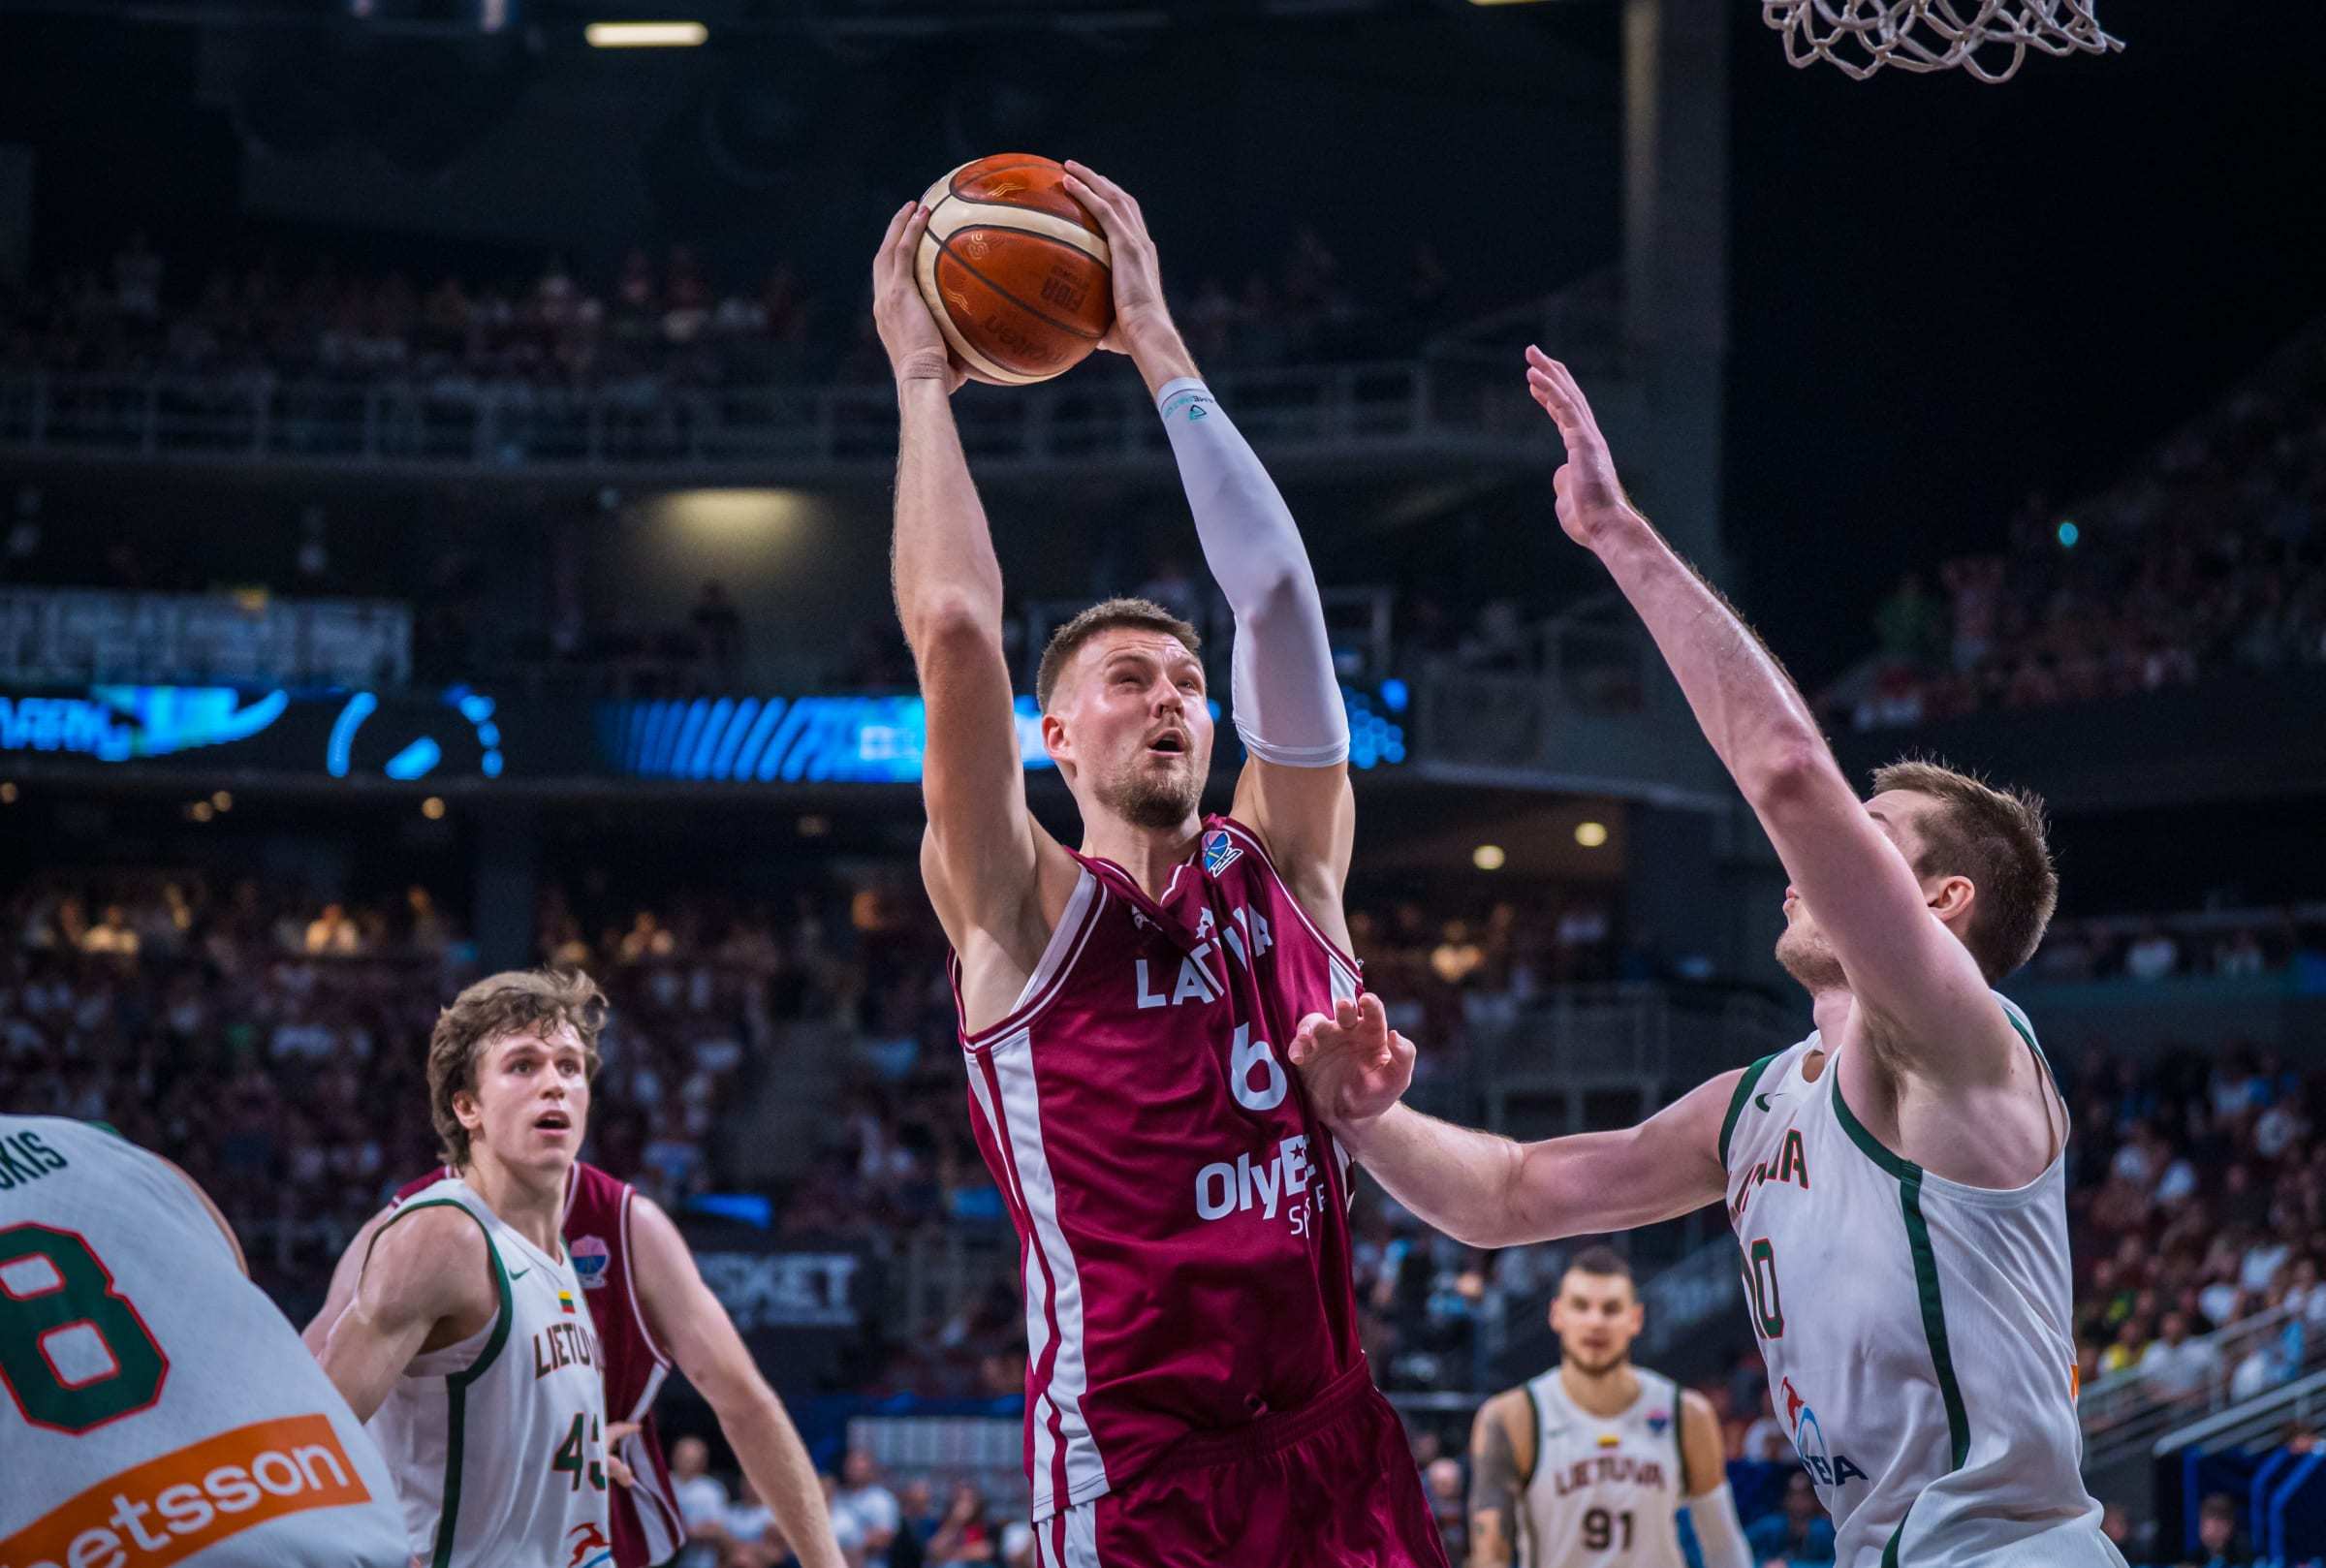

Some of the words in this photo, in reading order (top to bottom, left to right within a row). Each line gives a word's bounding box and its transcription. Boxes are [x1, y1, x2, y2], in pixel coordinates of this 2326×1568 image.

[1230, 1020, 1288, 1112] 6
[0, 1221, 171, 1437] 8
[0, 1443, 349, 1568] etsson
[1584, 1506, 1634, 1552] 91
